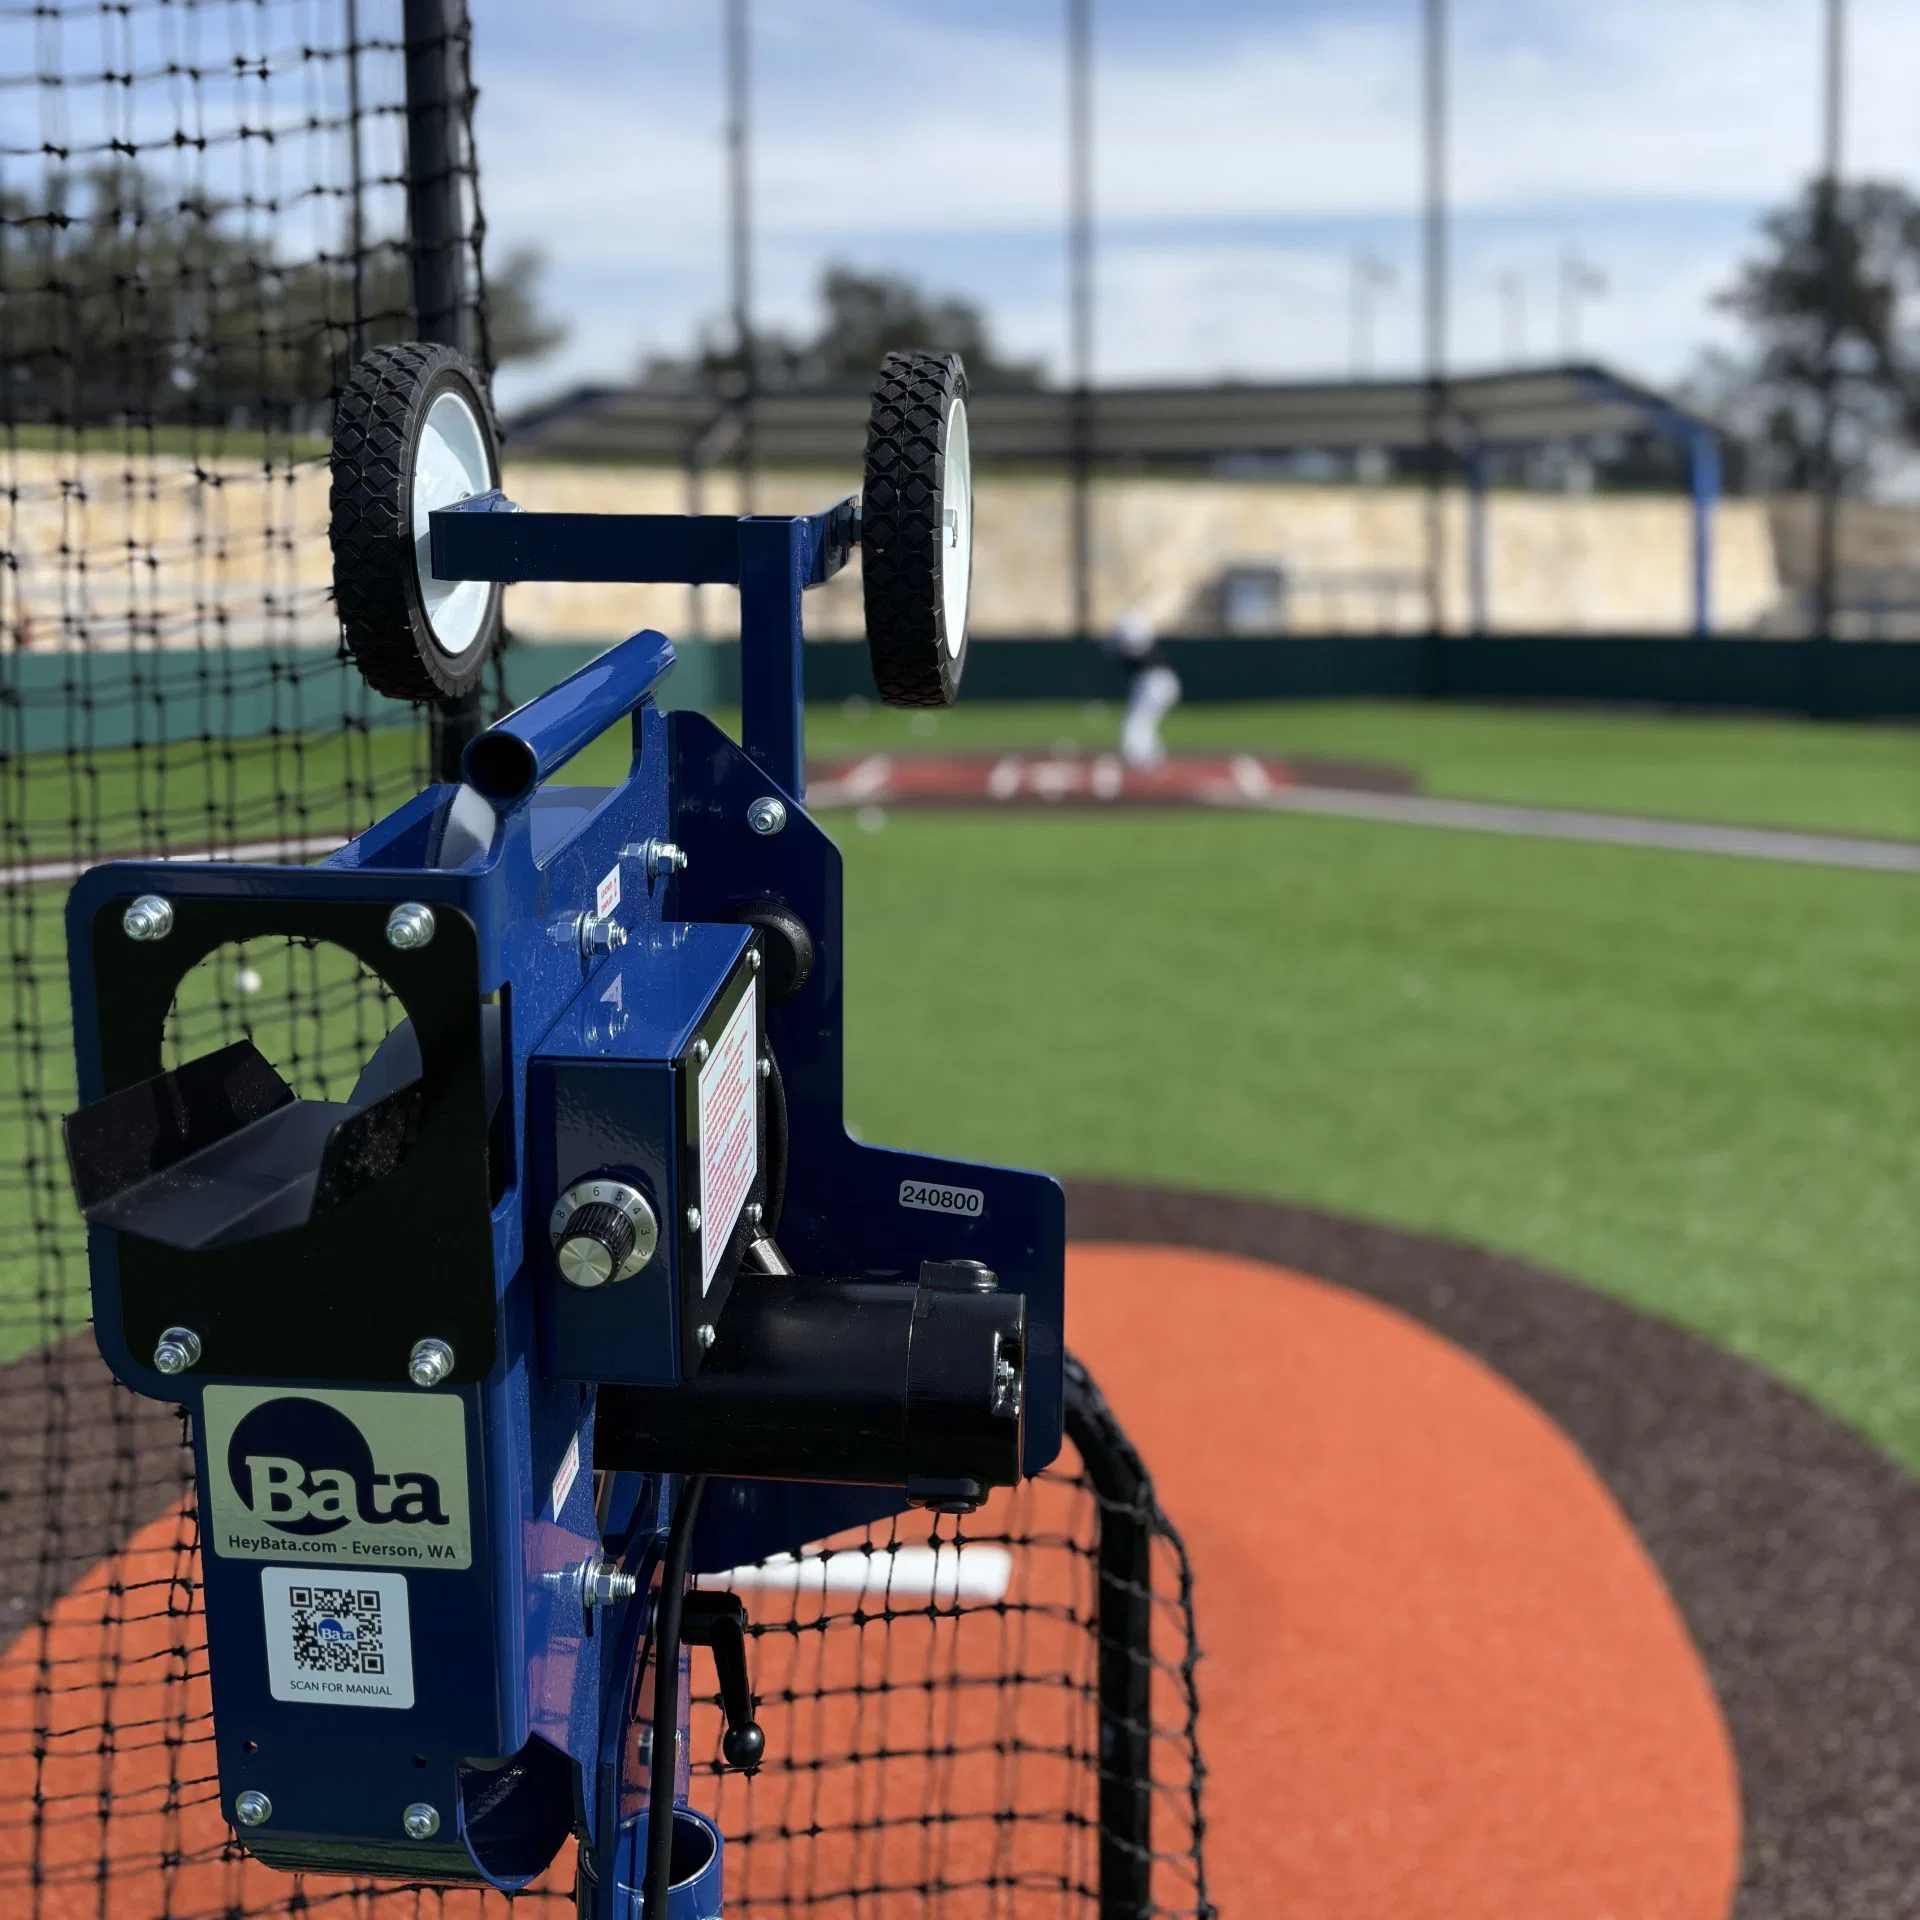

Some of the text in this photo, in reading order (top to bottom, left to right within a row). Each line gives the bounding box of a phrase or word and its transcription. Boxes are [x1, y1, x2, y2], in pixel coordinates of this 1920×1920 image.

[571, 1192, 577, 1202] 7
[593, 1187, 600, 1197] 6
[615, 1191, 624, 1201] 5
[902, 1186, 979, 1211] 240800
[557, 1209, 565, 1219] 8
[633, 1206, 641, 1215] 4
[641, 1228, 650, 1236] 3
[637, 1249, 647, 1257] 2
[624, 1265, 632, 1273] 1
[246, 1456, 450, 1525] Bata
[229, 1535, 337, 1553] HeyBata.com
[352, 1541, 423, 1560] Everson,
[427, 1545, 456, 1559] WA
[321, 1628, 355, 1640] Bata
[290, 1681, 392, 1695] SCAN FOR MANUAL
